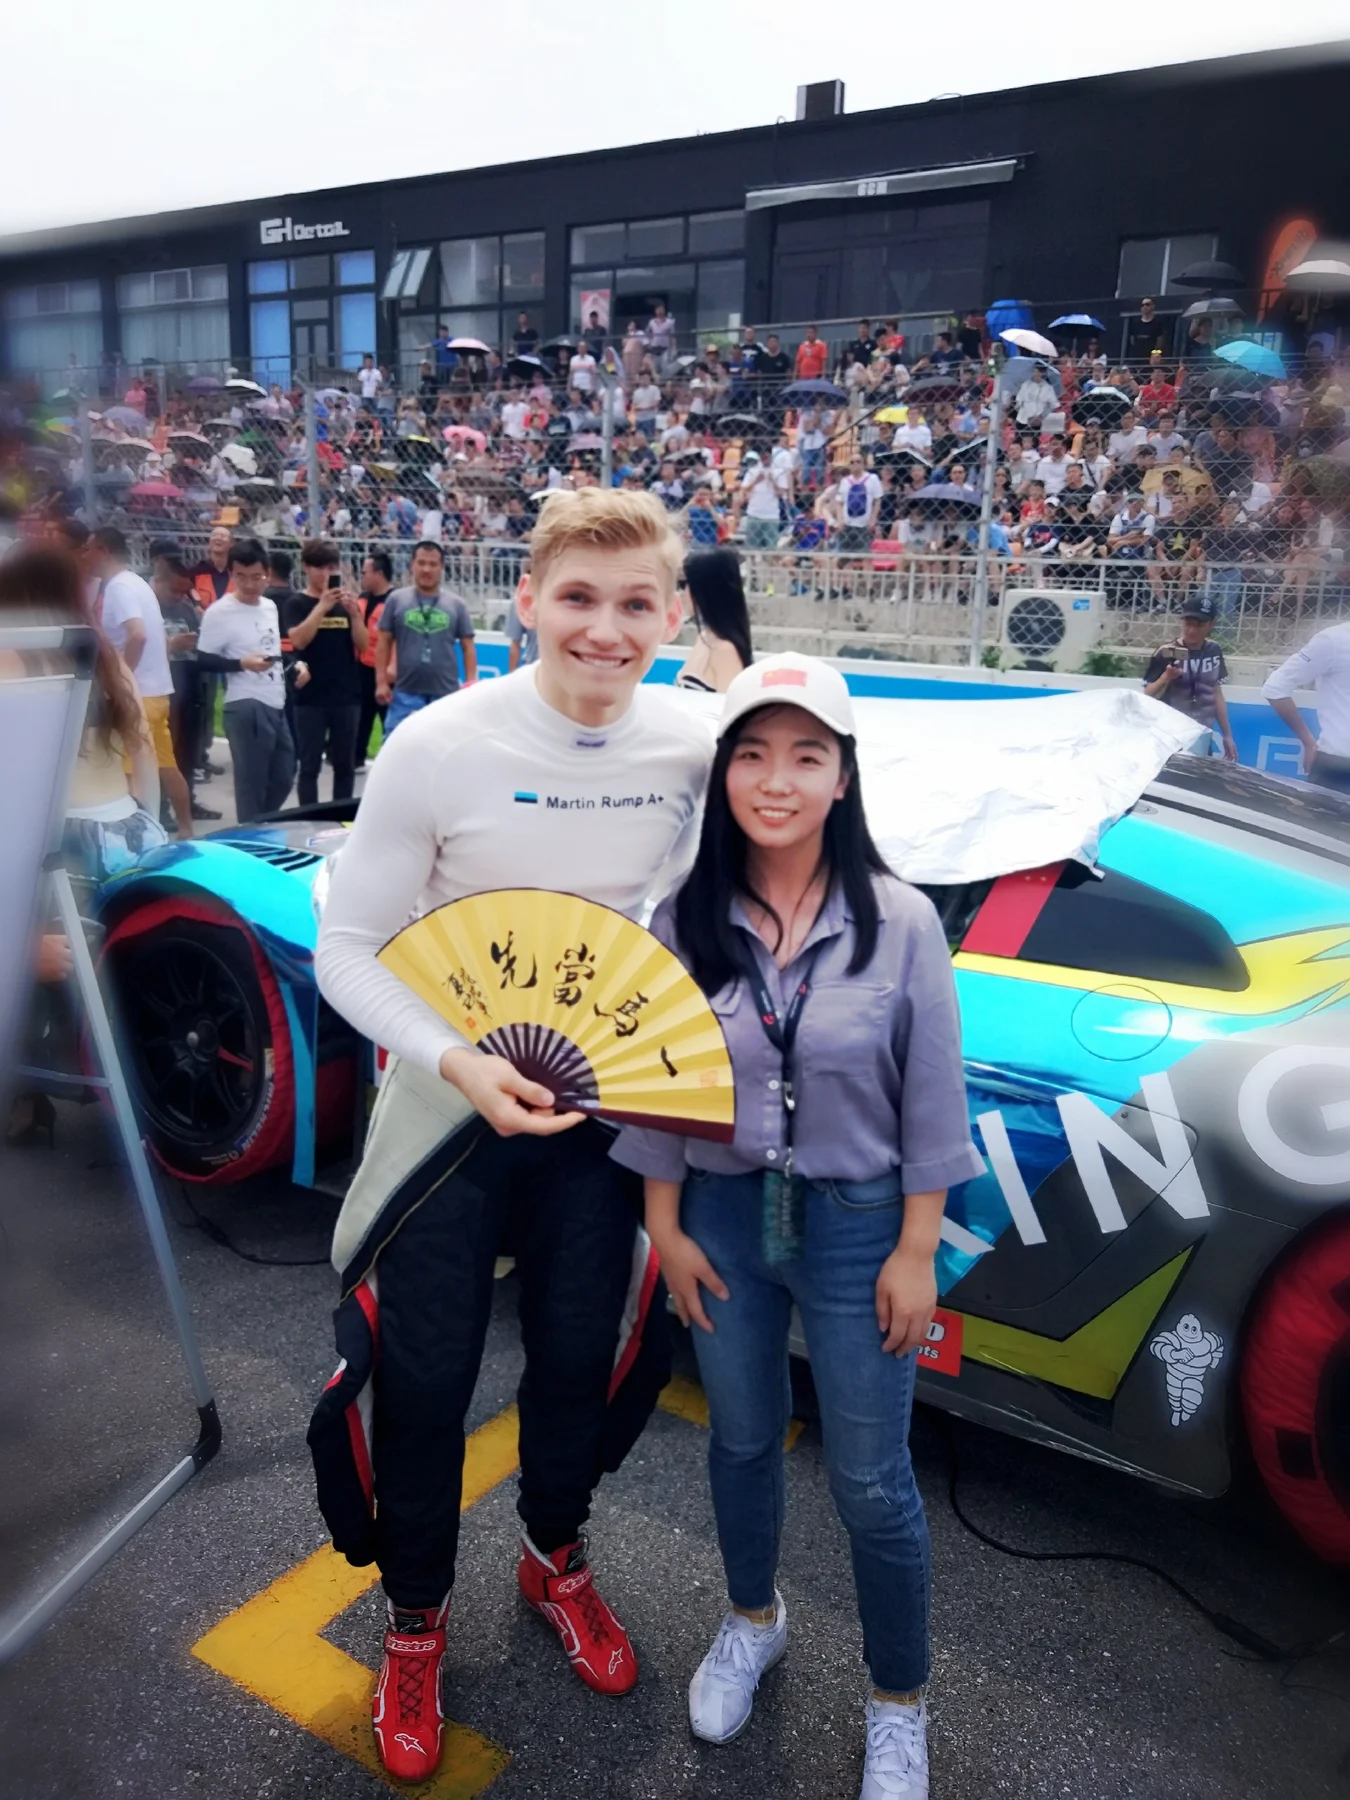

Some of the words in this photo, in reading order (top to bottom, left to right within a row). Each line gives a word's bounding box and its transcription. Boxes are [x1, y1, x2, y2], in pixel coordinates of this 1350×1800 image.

[1174, 655, 1221, 674] INGS
[546, 796, 596, 809] Martin
[601, 795, 644, 808] Rump
[940, 1044, 1350, 1256] ING
